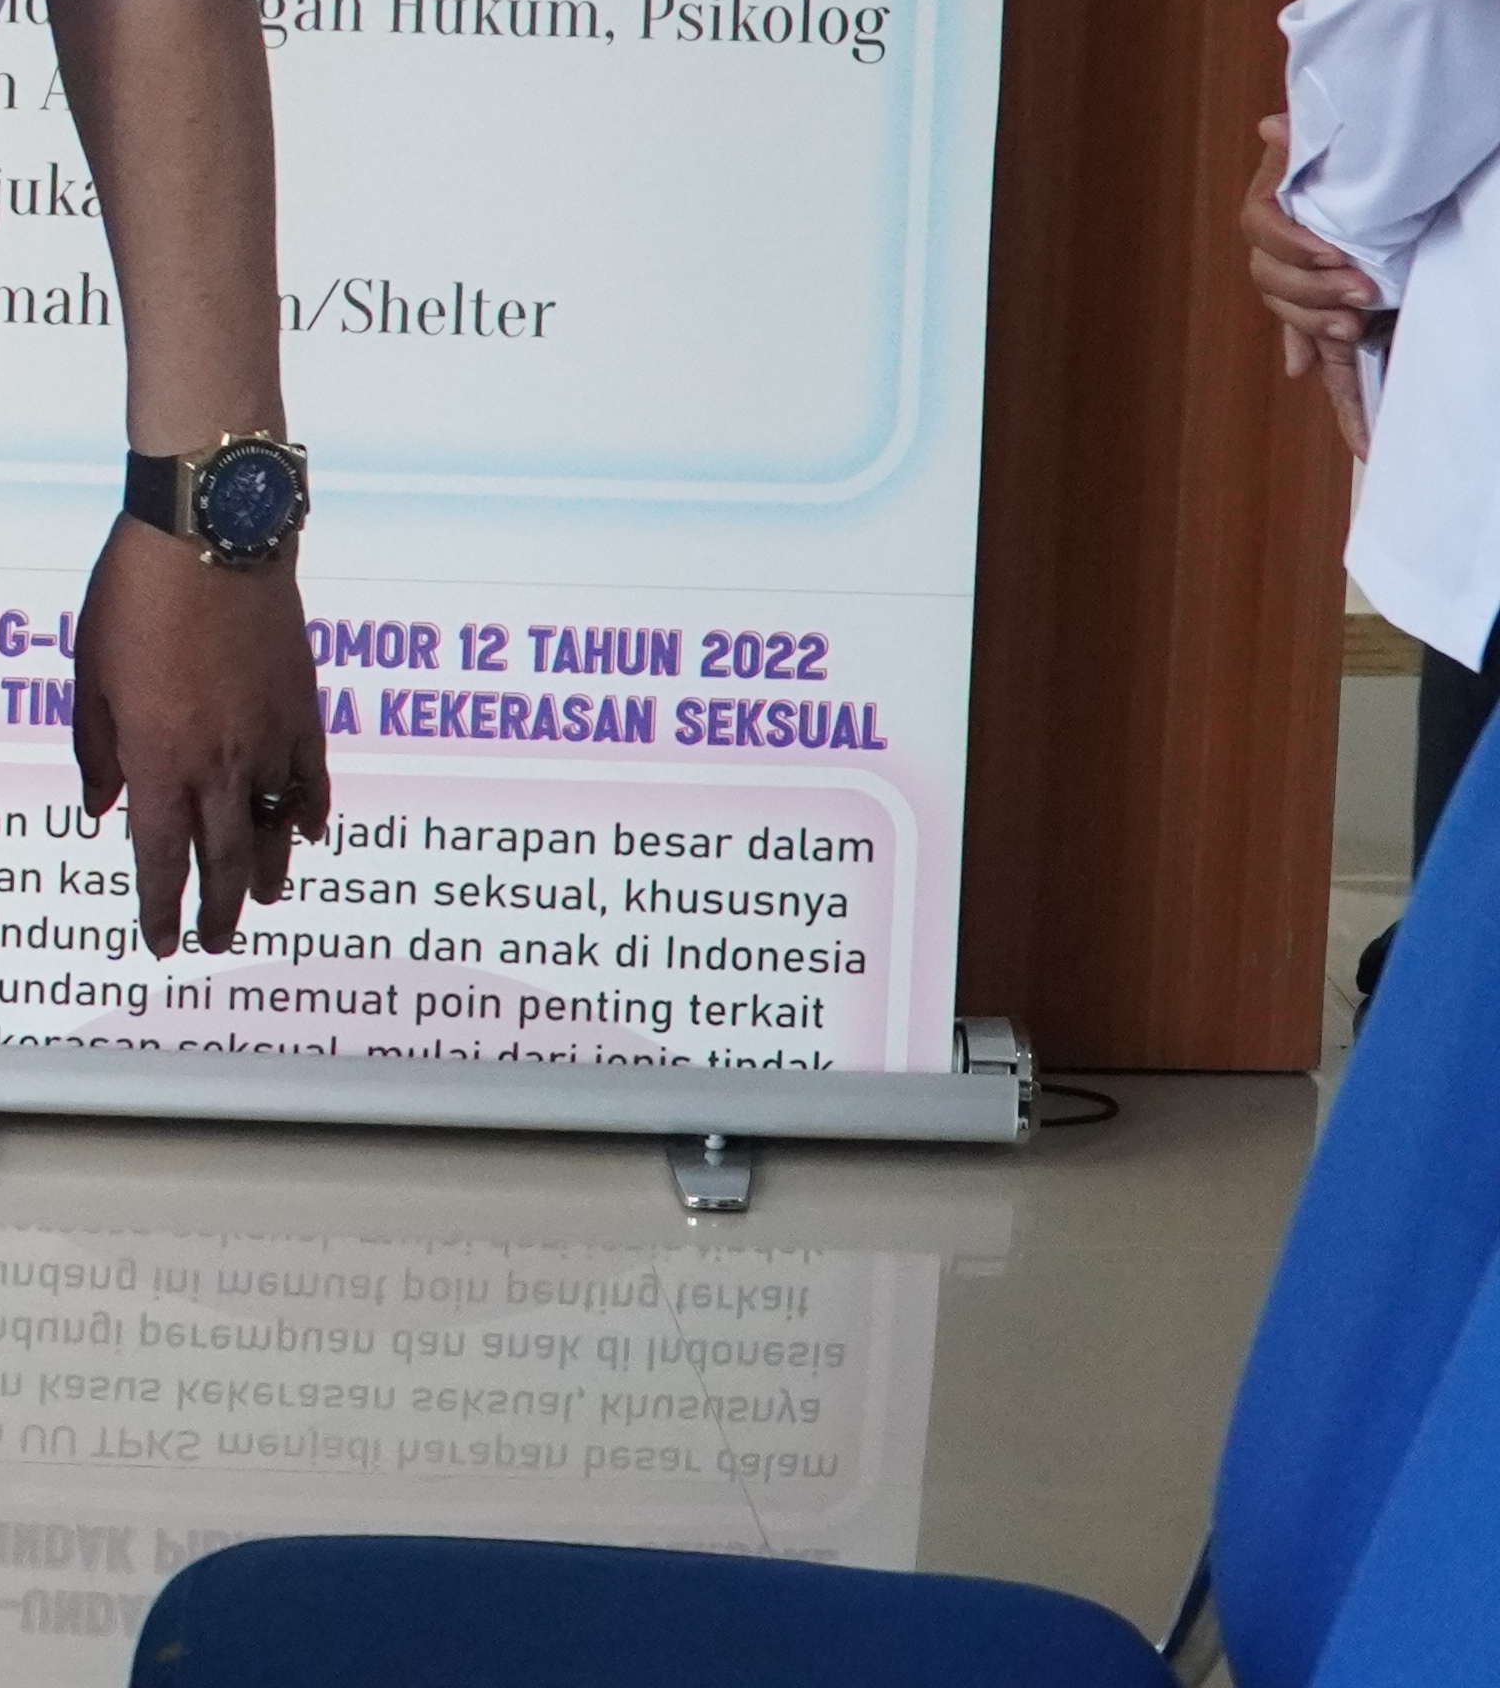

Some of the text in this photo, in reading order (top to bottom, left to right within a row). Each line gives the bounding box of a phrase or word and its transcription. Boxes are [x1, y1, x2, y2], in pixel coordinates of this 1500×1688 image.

[459, 623, 510, 672] 12
[528, 624, 683, 677] TAHUN
[700, 630, 830, 681] 2022
[380, 687, 657, 744] KEKERASAN
[674, 696, 889, 751] SEKSUAL
[425, 816, 596, 861] harapan
[614, 822, 733, 858] besar
[747, 826, 875, 863] dalam
[434, 874, 608, 919] seksual,
[625, 878, 849, 926] khususnya
[409, 928, 483, 963] dan
[500, 933, 601, 968] anak
[615, 935, 650, 970] di
[666, 935, 867, 975] Indonesia
[165, 975, 212, 1010] ini
[229, 982, 398, 1016] memuat
[416, 984, 502, 1025] poin
[519, 989, 673, 1033] penting
[689, 993, 826, 1030] terkait
